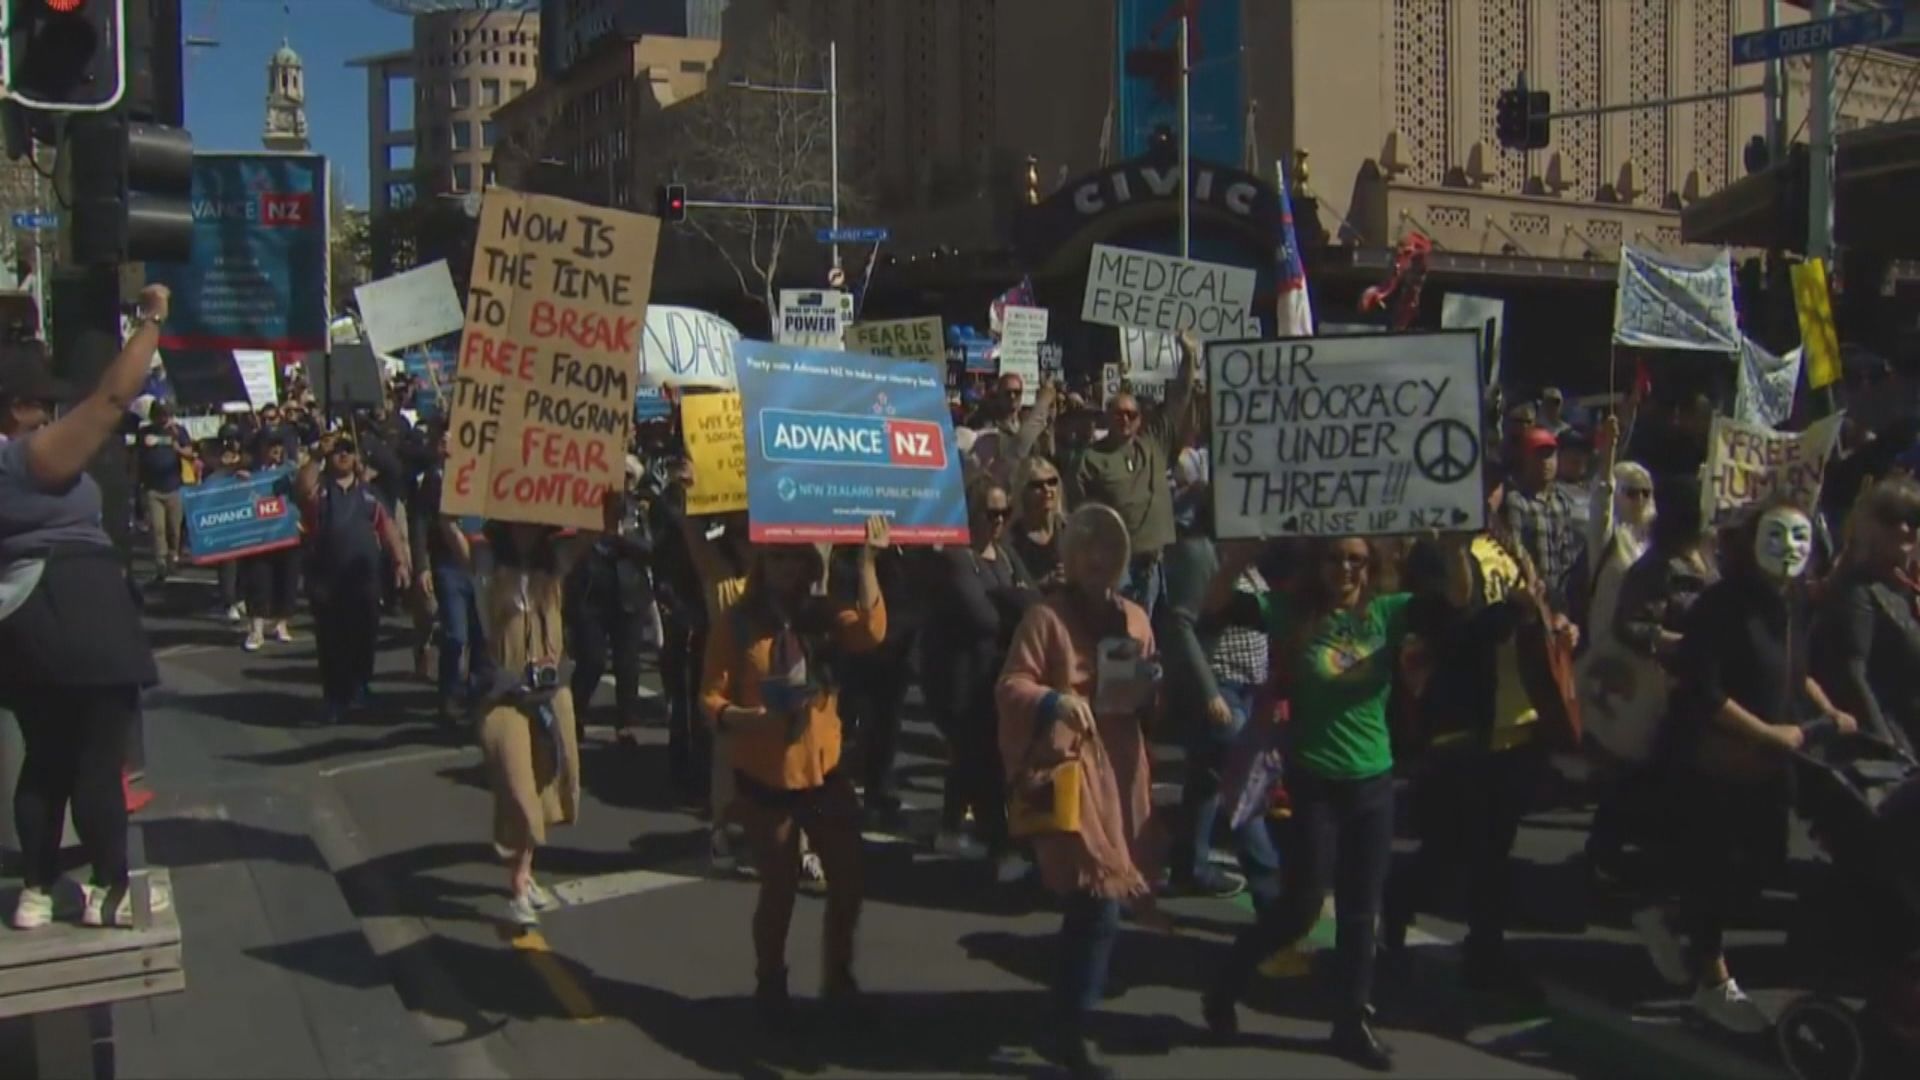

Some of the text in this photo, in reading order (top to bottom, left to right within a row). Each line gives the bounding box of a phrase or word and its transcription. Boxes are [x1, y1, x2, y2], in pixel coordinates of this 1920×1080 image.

[1779, 23, 1833, 50] QUEEN
[267, 201, 302, 220] NZ
[1073, 167, 1257, 215] CIVIC
[502, 207, 616, 259] NOW IS
[484, 247, 632, 306] THE TIME
[1098, 252, 1239, 305] MEDICAL
[470, 287, 638, 353] TO BREAK
[785, 316, 836, 333] POWER
[858, 322, 932, 345] FEAR IS
[1092, 288, 1245, 337] FREEDOM
[463, 330, 539, 381] FREE
[551, 353, 629, 402] FROM
[1221, 344, 1319, 389] OUR
[456, 377, 629, 438] THE PROGRAM
[1216, 376, 1450, 427] DEMOCRACY
[459, 421, 609, 473] OF FEAR
[773, 421, 933, 458] ADVANCE NZ
[1217, 422, 1398, 466] IS UNDER
[492, 468, 610, 508] CONTRO
[800, 482, 824, 497] NEW
[826, 483, 873, 498] ZEALAND
[875, 484, 911, 499] PUBLIC
[200, 500, 280, 528] ADVANCE NZ
[1300, 510, 1359, 533] RISE
[1368, 511, 1398, 530] UP
